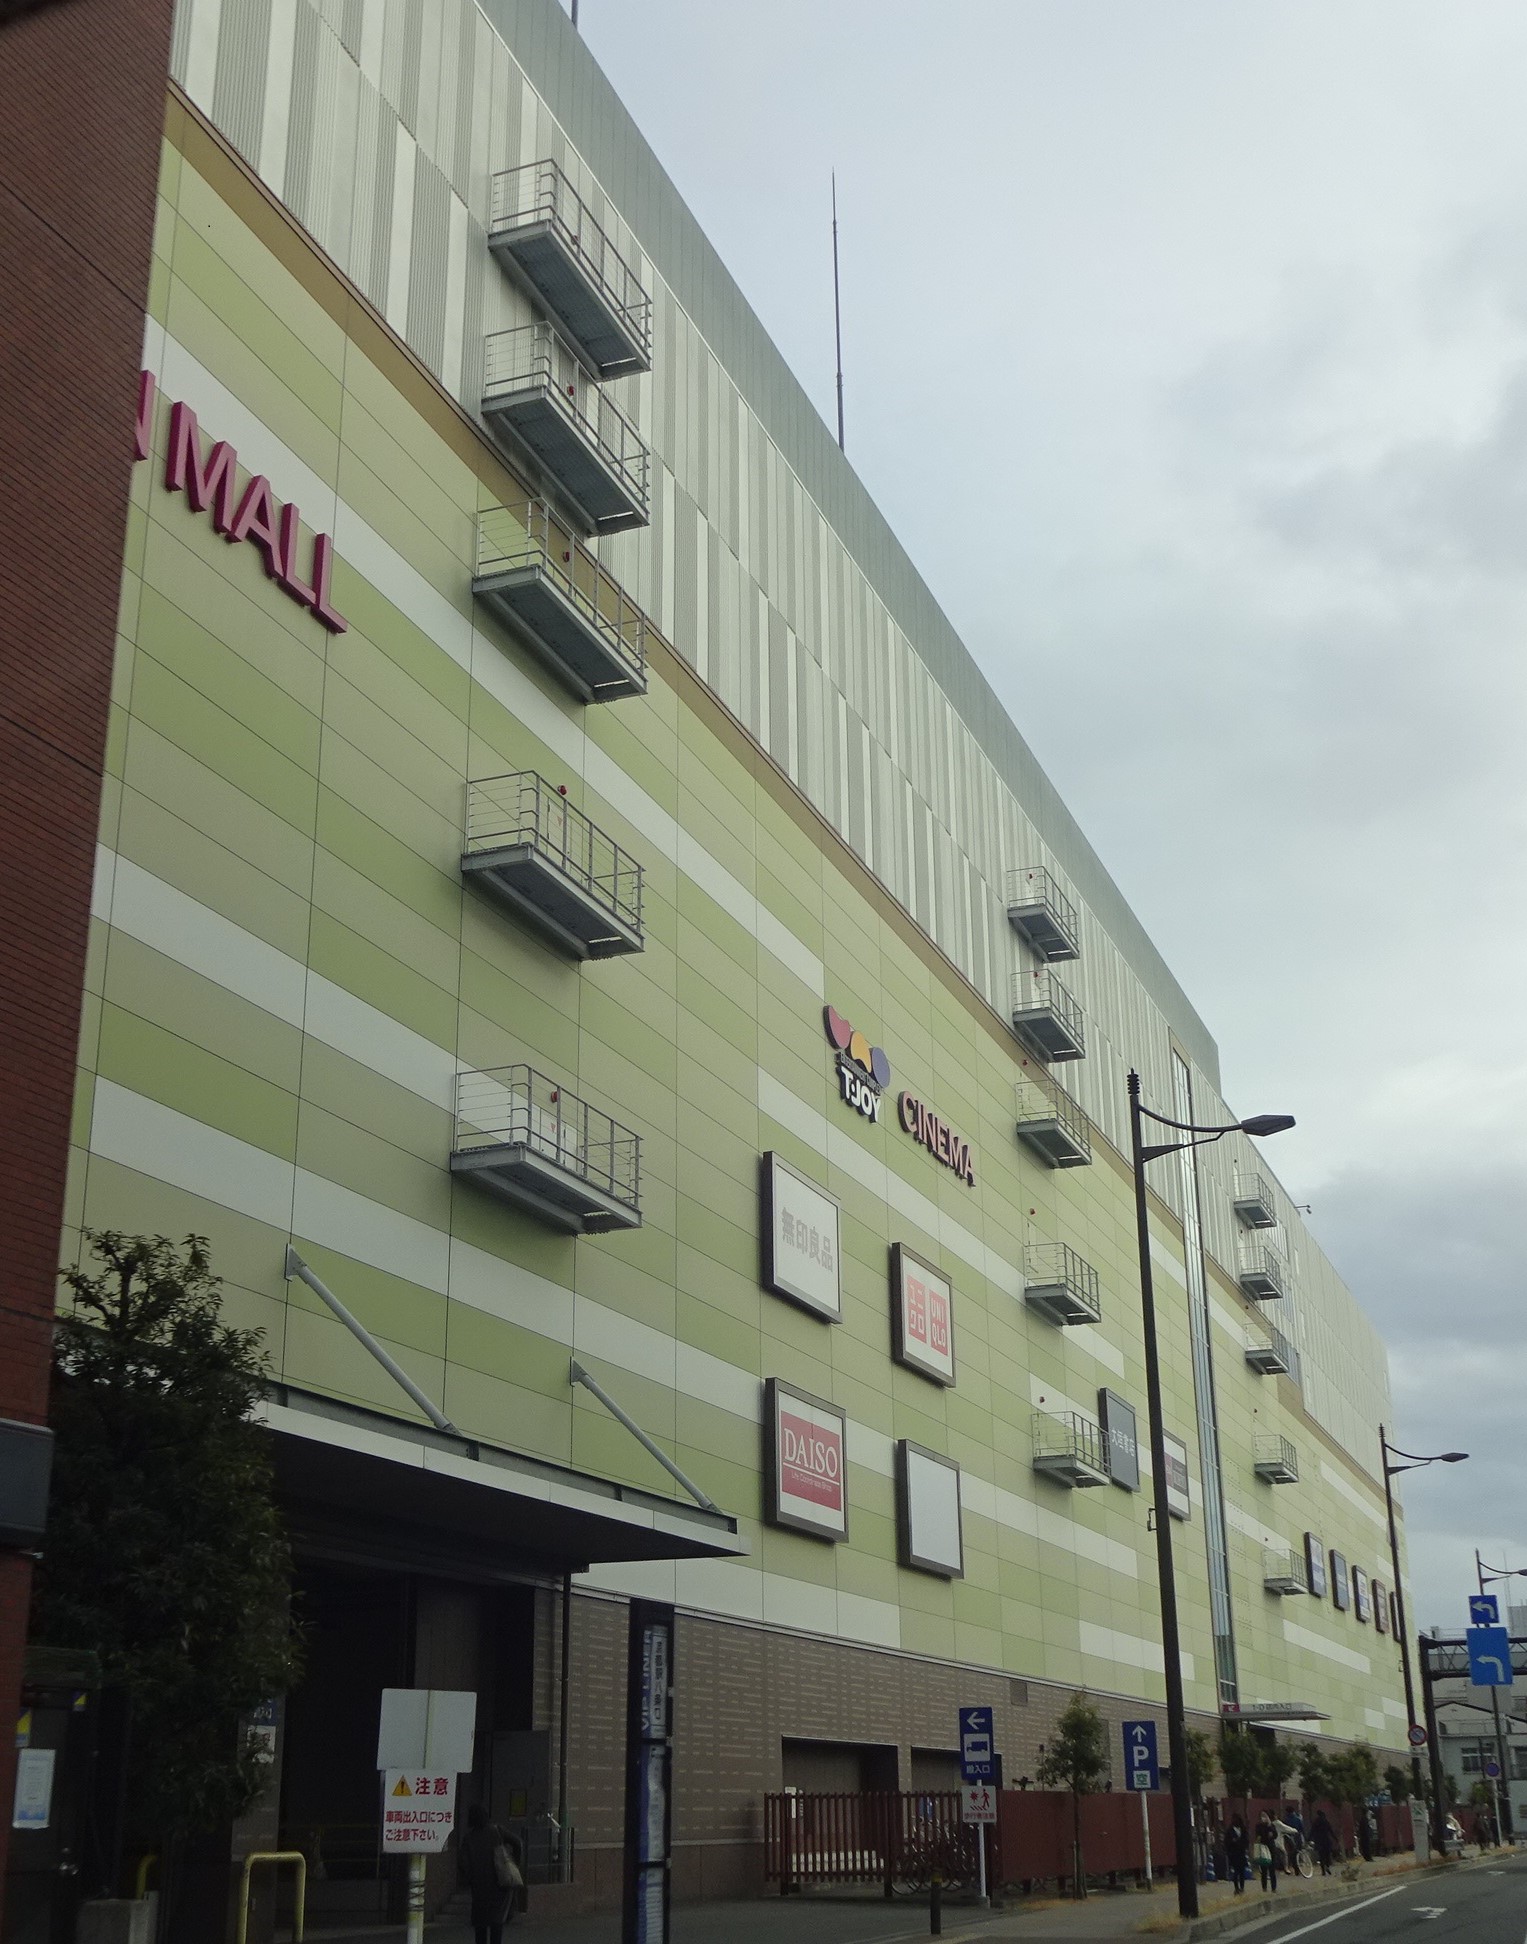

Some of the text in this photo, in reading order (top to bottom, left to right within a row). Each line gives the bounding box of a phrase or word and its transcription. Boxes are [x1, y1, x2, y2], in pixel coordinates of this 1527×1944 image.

[165, 400, 348, 635] MALL
[898, 1091, 976, 1188] CINEMA
[781, 1206, 834, 1274] 無印良品
[784, 1427, 838, 1479] DAISO
[1133, 1746, 1149, 1767] P
[415, 1777, 449, 1796] 注意
[385, 1810, 452, 1824] 車両出入口につき
